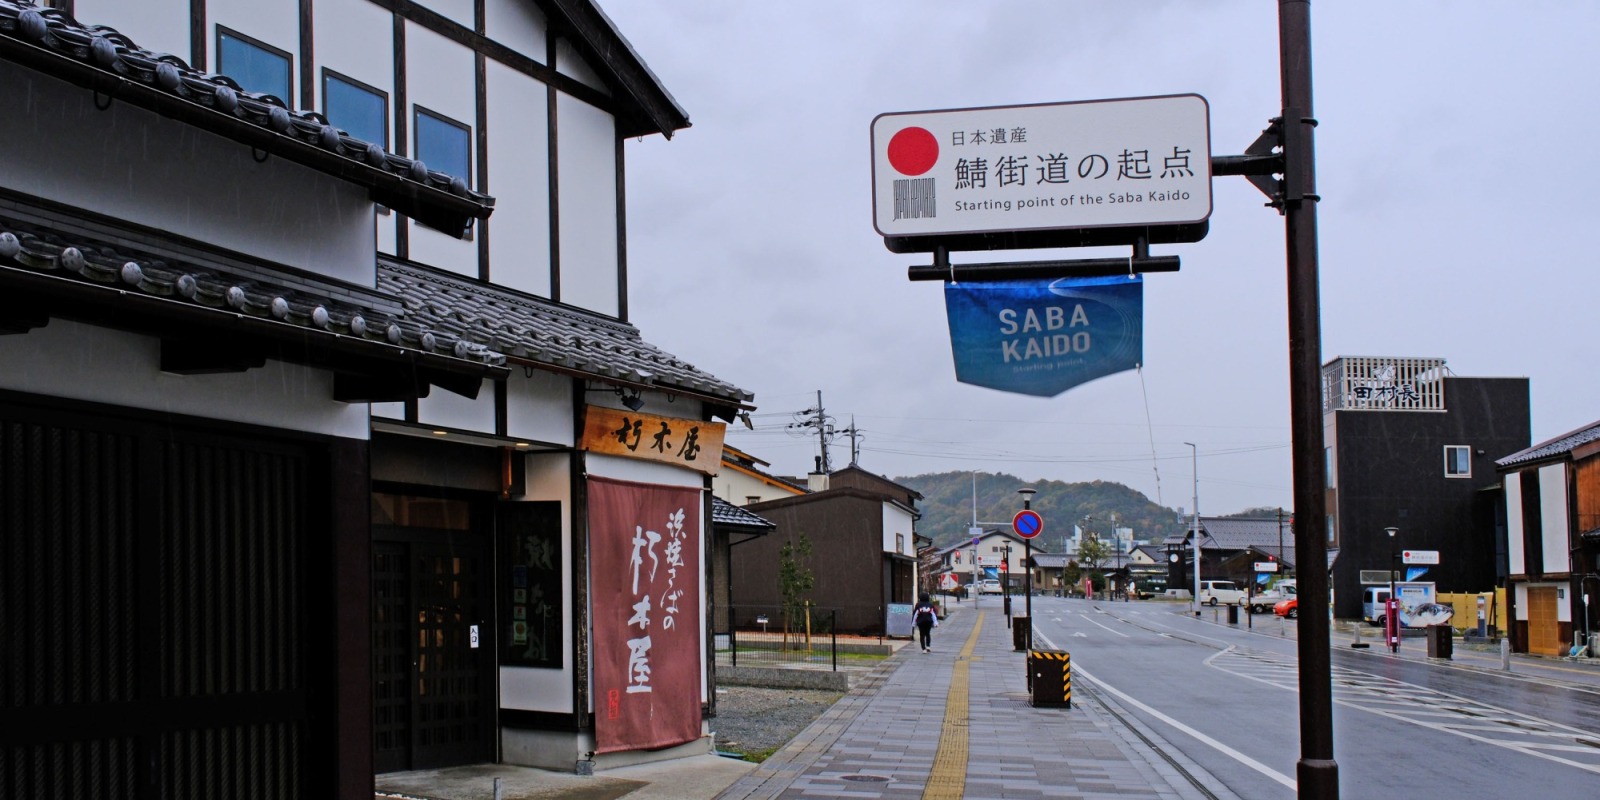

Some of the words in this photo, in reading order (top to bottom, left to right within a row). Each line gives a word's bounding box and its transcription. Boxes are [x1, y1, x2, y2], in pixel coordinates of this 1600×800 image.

[952, 126, 1028, 147] 日本遺産
[954, 146, 1195, 190] 鯖街道の起点
[955, 199, 1012, 212] Starting
[1017, 197, 1055, 211] point
[1060, 194, 1075, 206] of
[1079, 193, 1103, 205] the
[1108, 192, 1143, 204] Saba
[1149, 189, 1190, 202] Kaido
[998, 303, 1089, 335] SABA
[1001, 331, 1091, 363] KAIDO
[1012, 362, 1054, 374] Starting
[1353, 384, 1421, 402] 田村長
[611, 417, 701, 461] 朽木屋
[625, 525, 662, 694] 朽木屋
[470, 627, 478, 643] 入口
